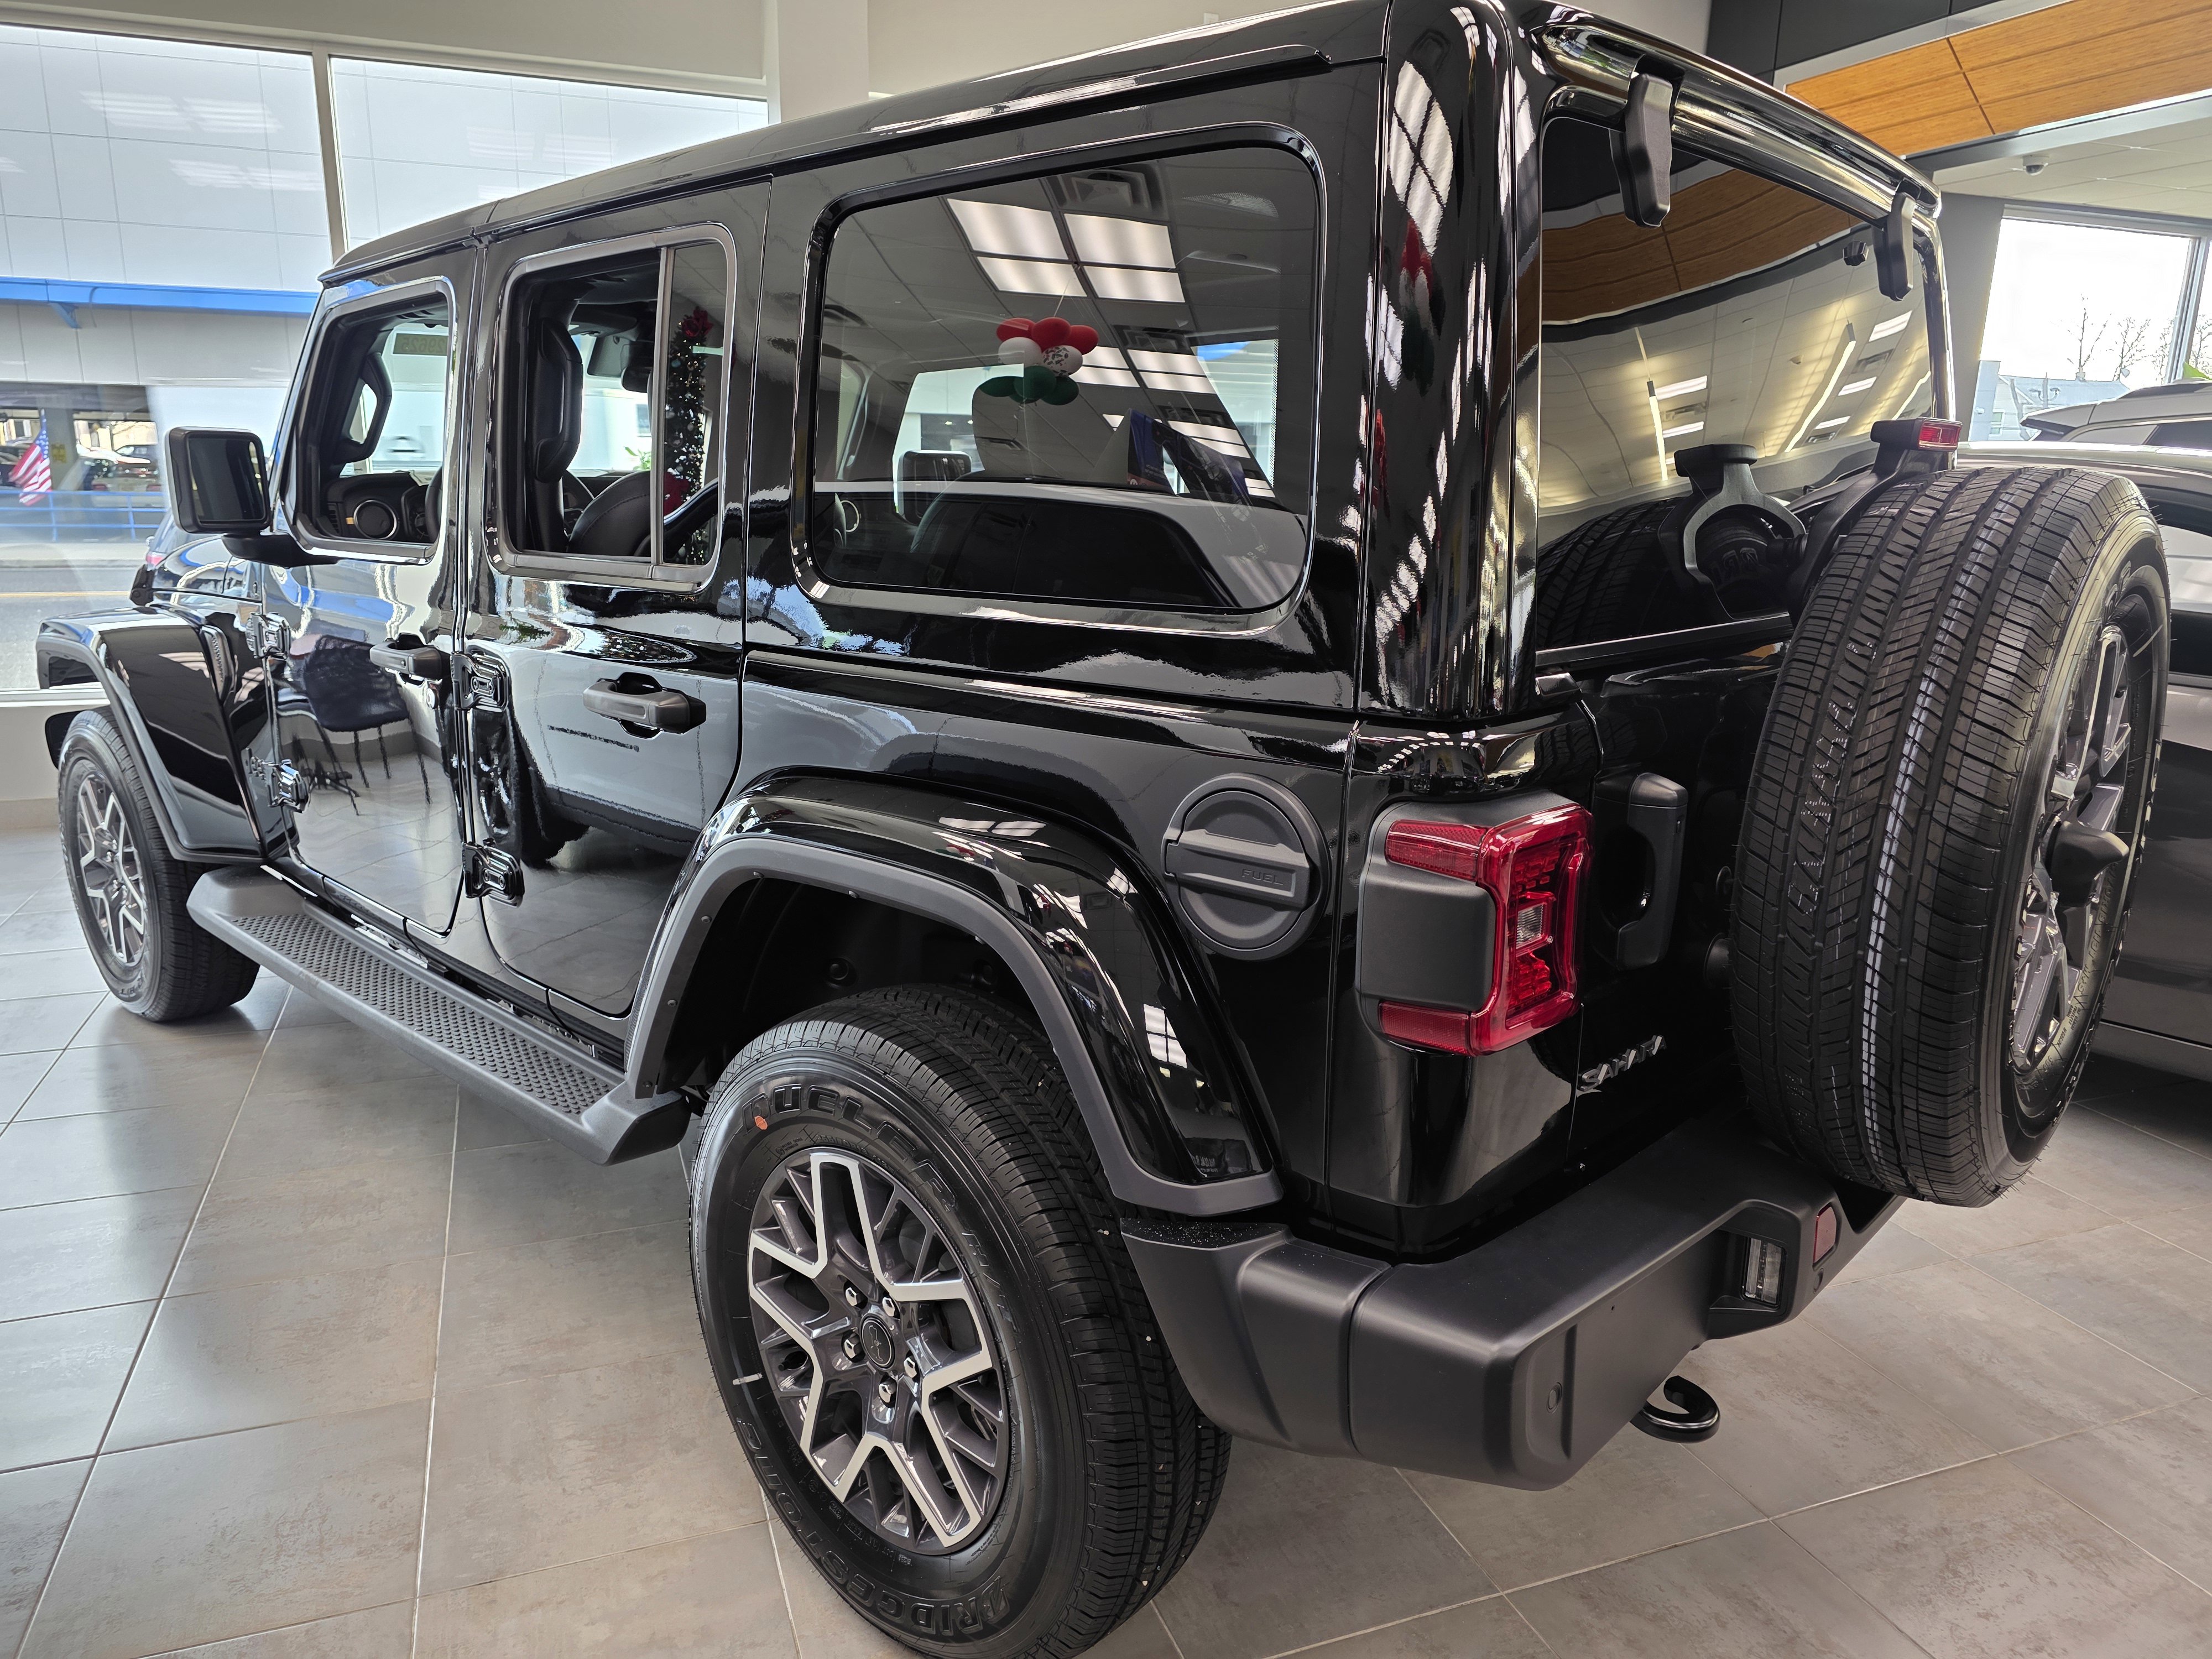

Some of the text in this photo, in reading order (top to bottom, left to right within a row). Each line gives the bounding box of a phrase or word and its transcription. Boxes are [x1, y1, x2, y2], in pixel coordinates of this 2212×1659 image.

[1241, 868, 1284, 885] FUEL
[1577, 1035, 1667, 1092] SAHARA
[742, 1082, 957, 1214] DUELER
[735, 1417, 1011, 1637] BRIDGESTONE
